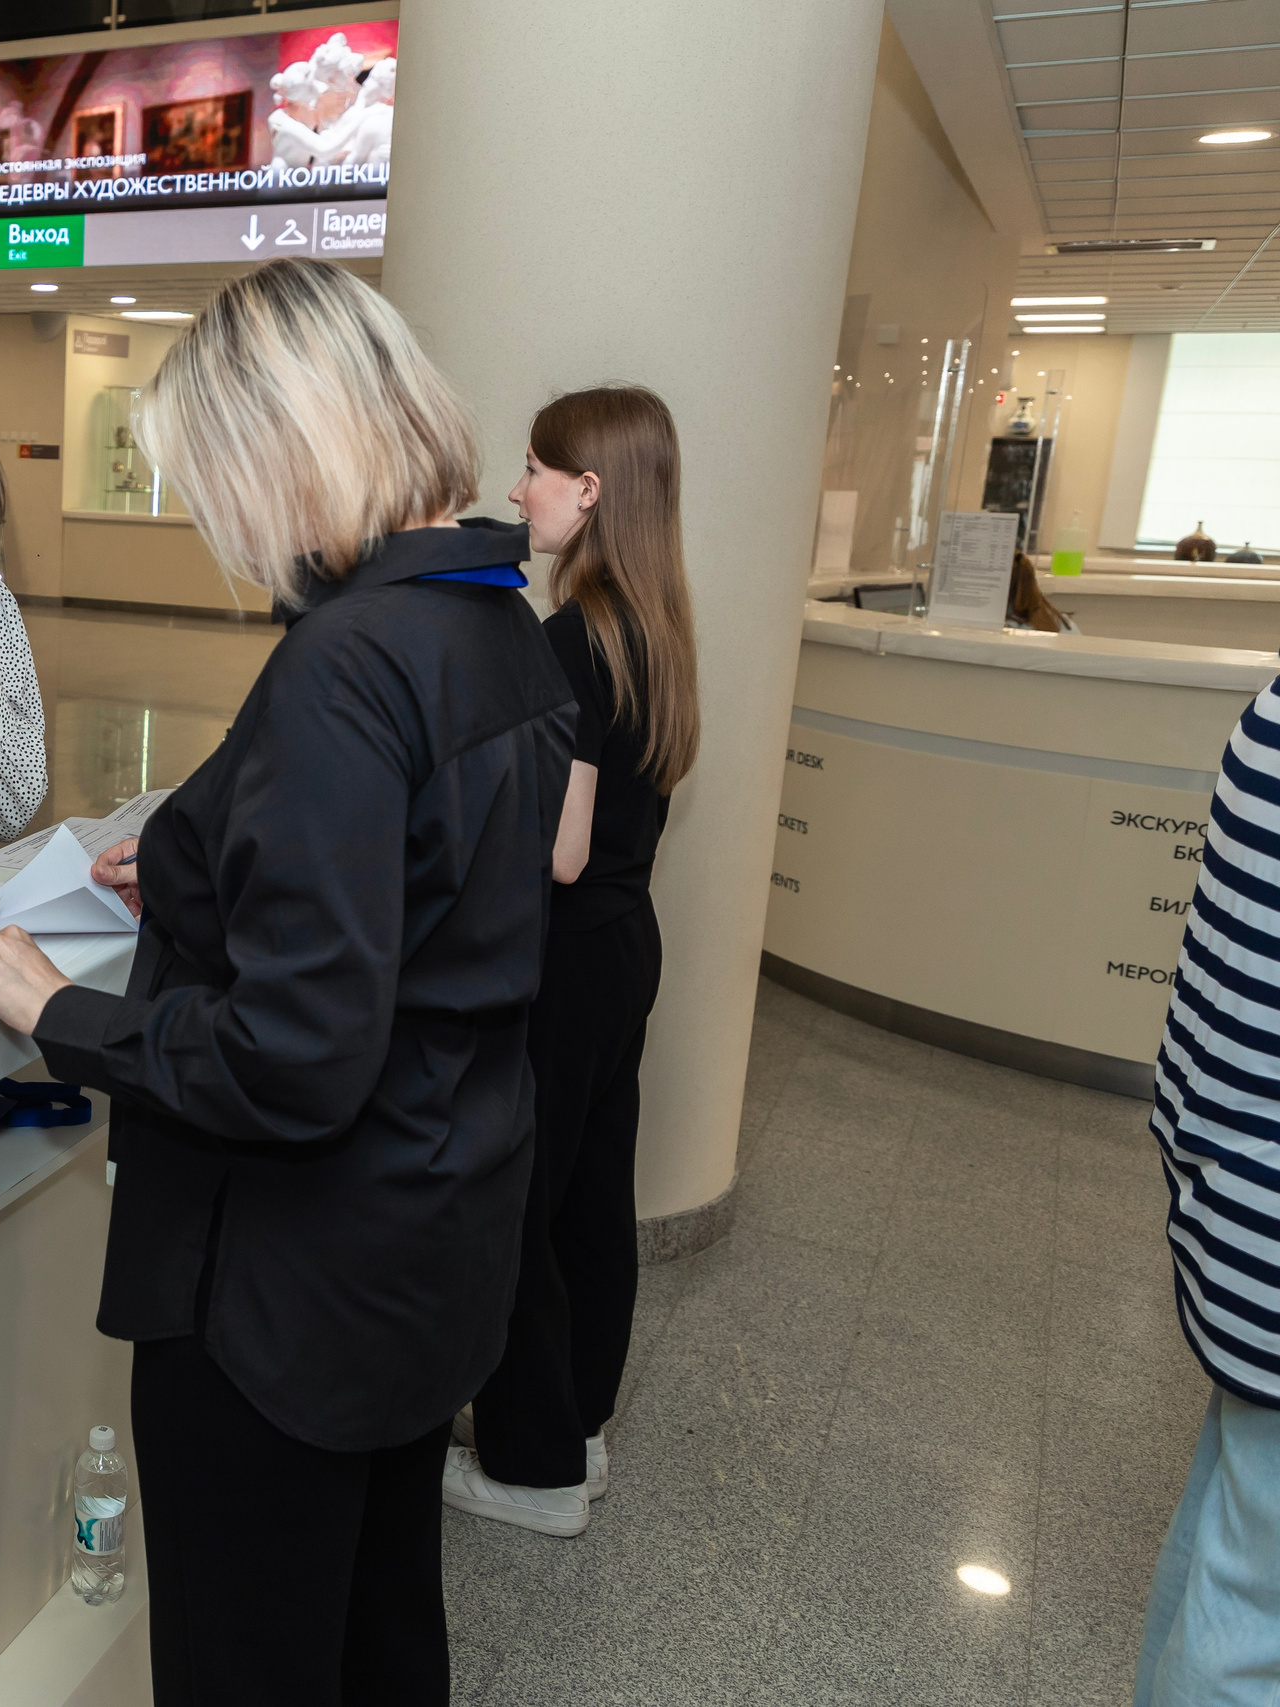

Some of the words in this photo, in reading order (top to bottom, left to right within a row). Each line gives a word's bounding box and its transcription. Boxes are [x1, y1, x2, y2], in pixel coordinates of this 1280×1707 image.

[64, 153, 147, 171] экспозиция
[72, 165, 274, 201] ХУДОЖЕСТВЕННОЙ
[8, 223, 70, 246] Выход
[797, 751, 824, 770] DESK
